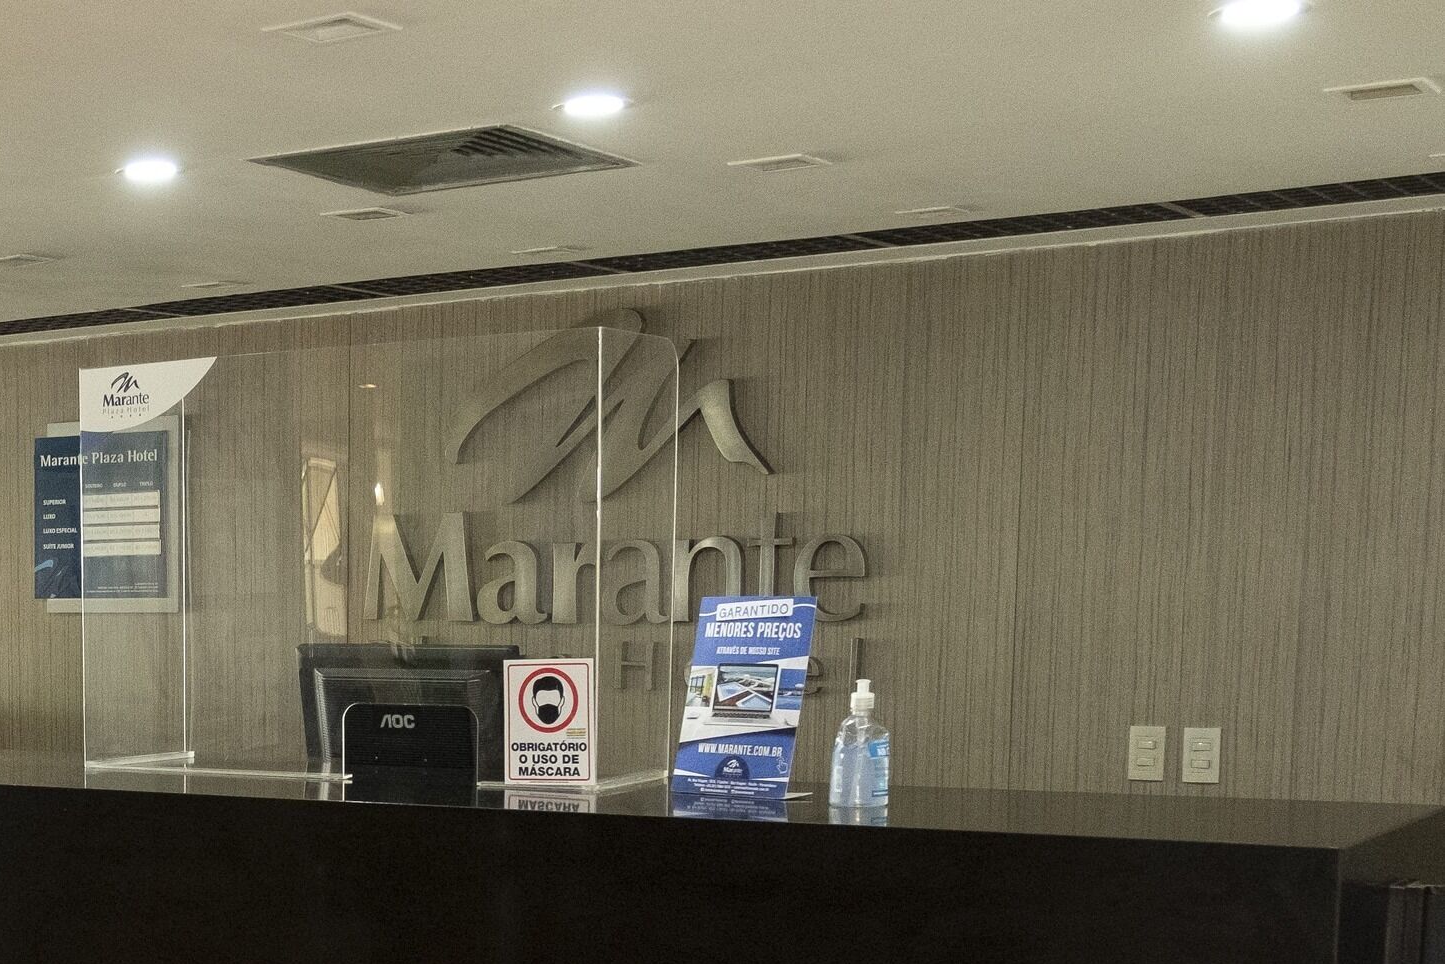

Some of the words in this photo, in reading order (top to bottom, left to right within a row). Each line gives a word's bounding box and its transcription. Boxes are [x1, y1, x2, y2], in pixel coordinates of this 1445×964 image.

[102, 392, 150, 407] Marante
[40, 454, 88, 467] Marante
[91, 451, 124, 465] Plaza
[127, 449, 158, 463] Hotel
[363, 511, 866, 626] Marante
[719, 603, 789, 618] GARANTIDO
[704, 622, 754, 638] MENORES
[756, 622, 803, 640] PREÇOS
[740, 646, 748, 655] DE
[749, 647, 767, 655] NOSSO
[767, 647, 781, 655] SITE
[380, 714, 415, 729] AOC
[511, 739, 587, 752] OBRIGATÓRIO
[698, 742, 783, 757] WWW.MARANTE.COM.BR
[518, 754, 528, 765] O
[531, 754, 558, 764] USO
[562, 754, 580, 764] DE
[518, 763, 581, 777] MÁSCARA
